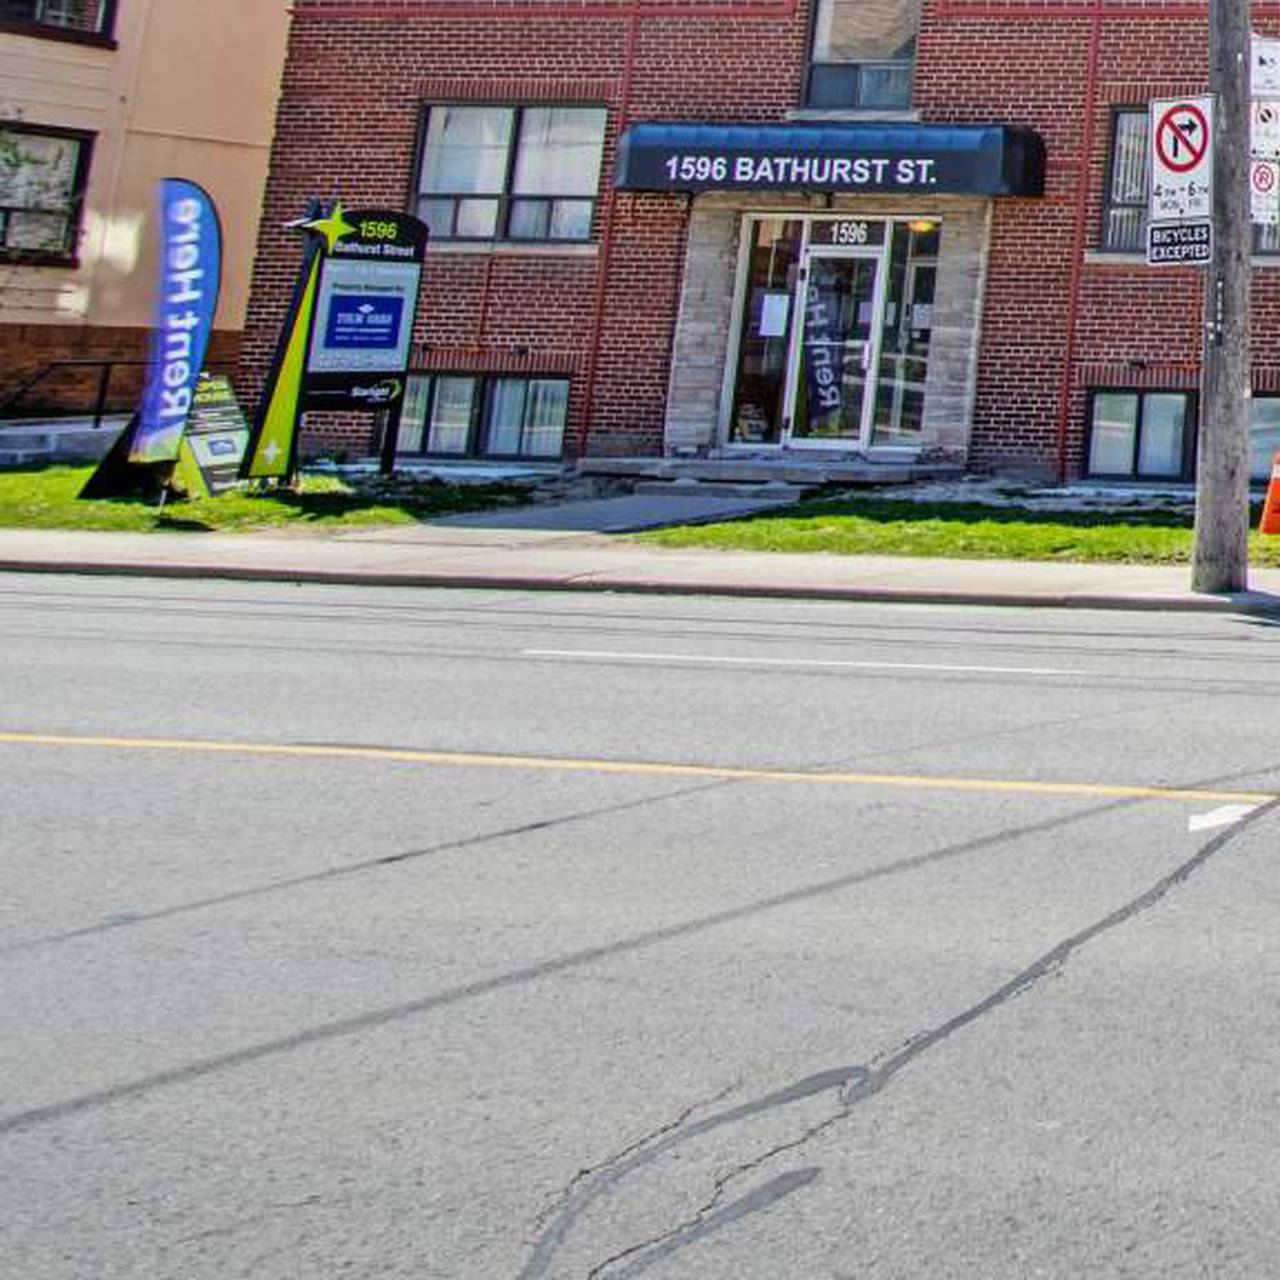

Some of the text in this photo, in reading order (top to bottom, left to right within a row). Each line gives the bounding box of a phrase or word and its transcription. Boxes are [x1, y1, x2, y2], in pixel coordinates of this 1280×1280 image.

[665, 154, 937, 185] 1596 BATHURST ST.
[359, 222, 398, 239] 1596
[830, 222, 868, 244] 1596
[1152, 227, 1208, 243] BICYCLES
[1151, 244, 1209, 260] EXCEPTED
